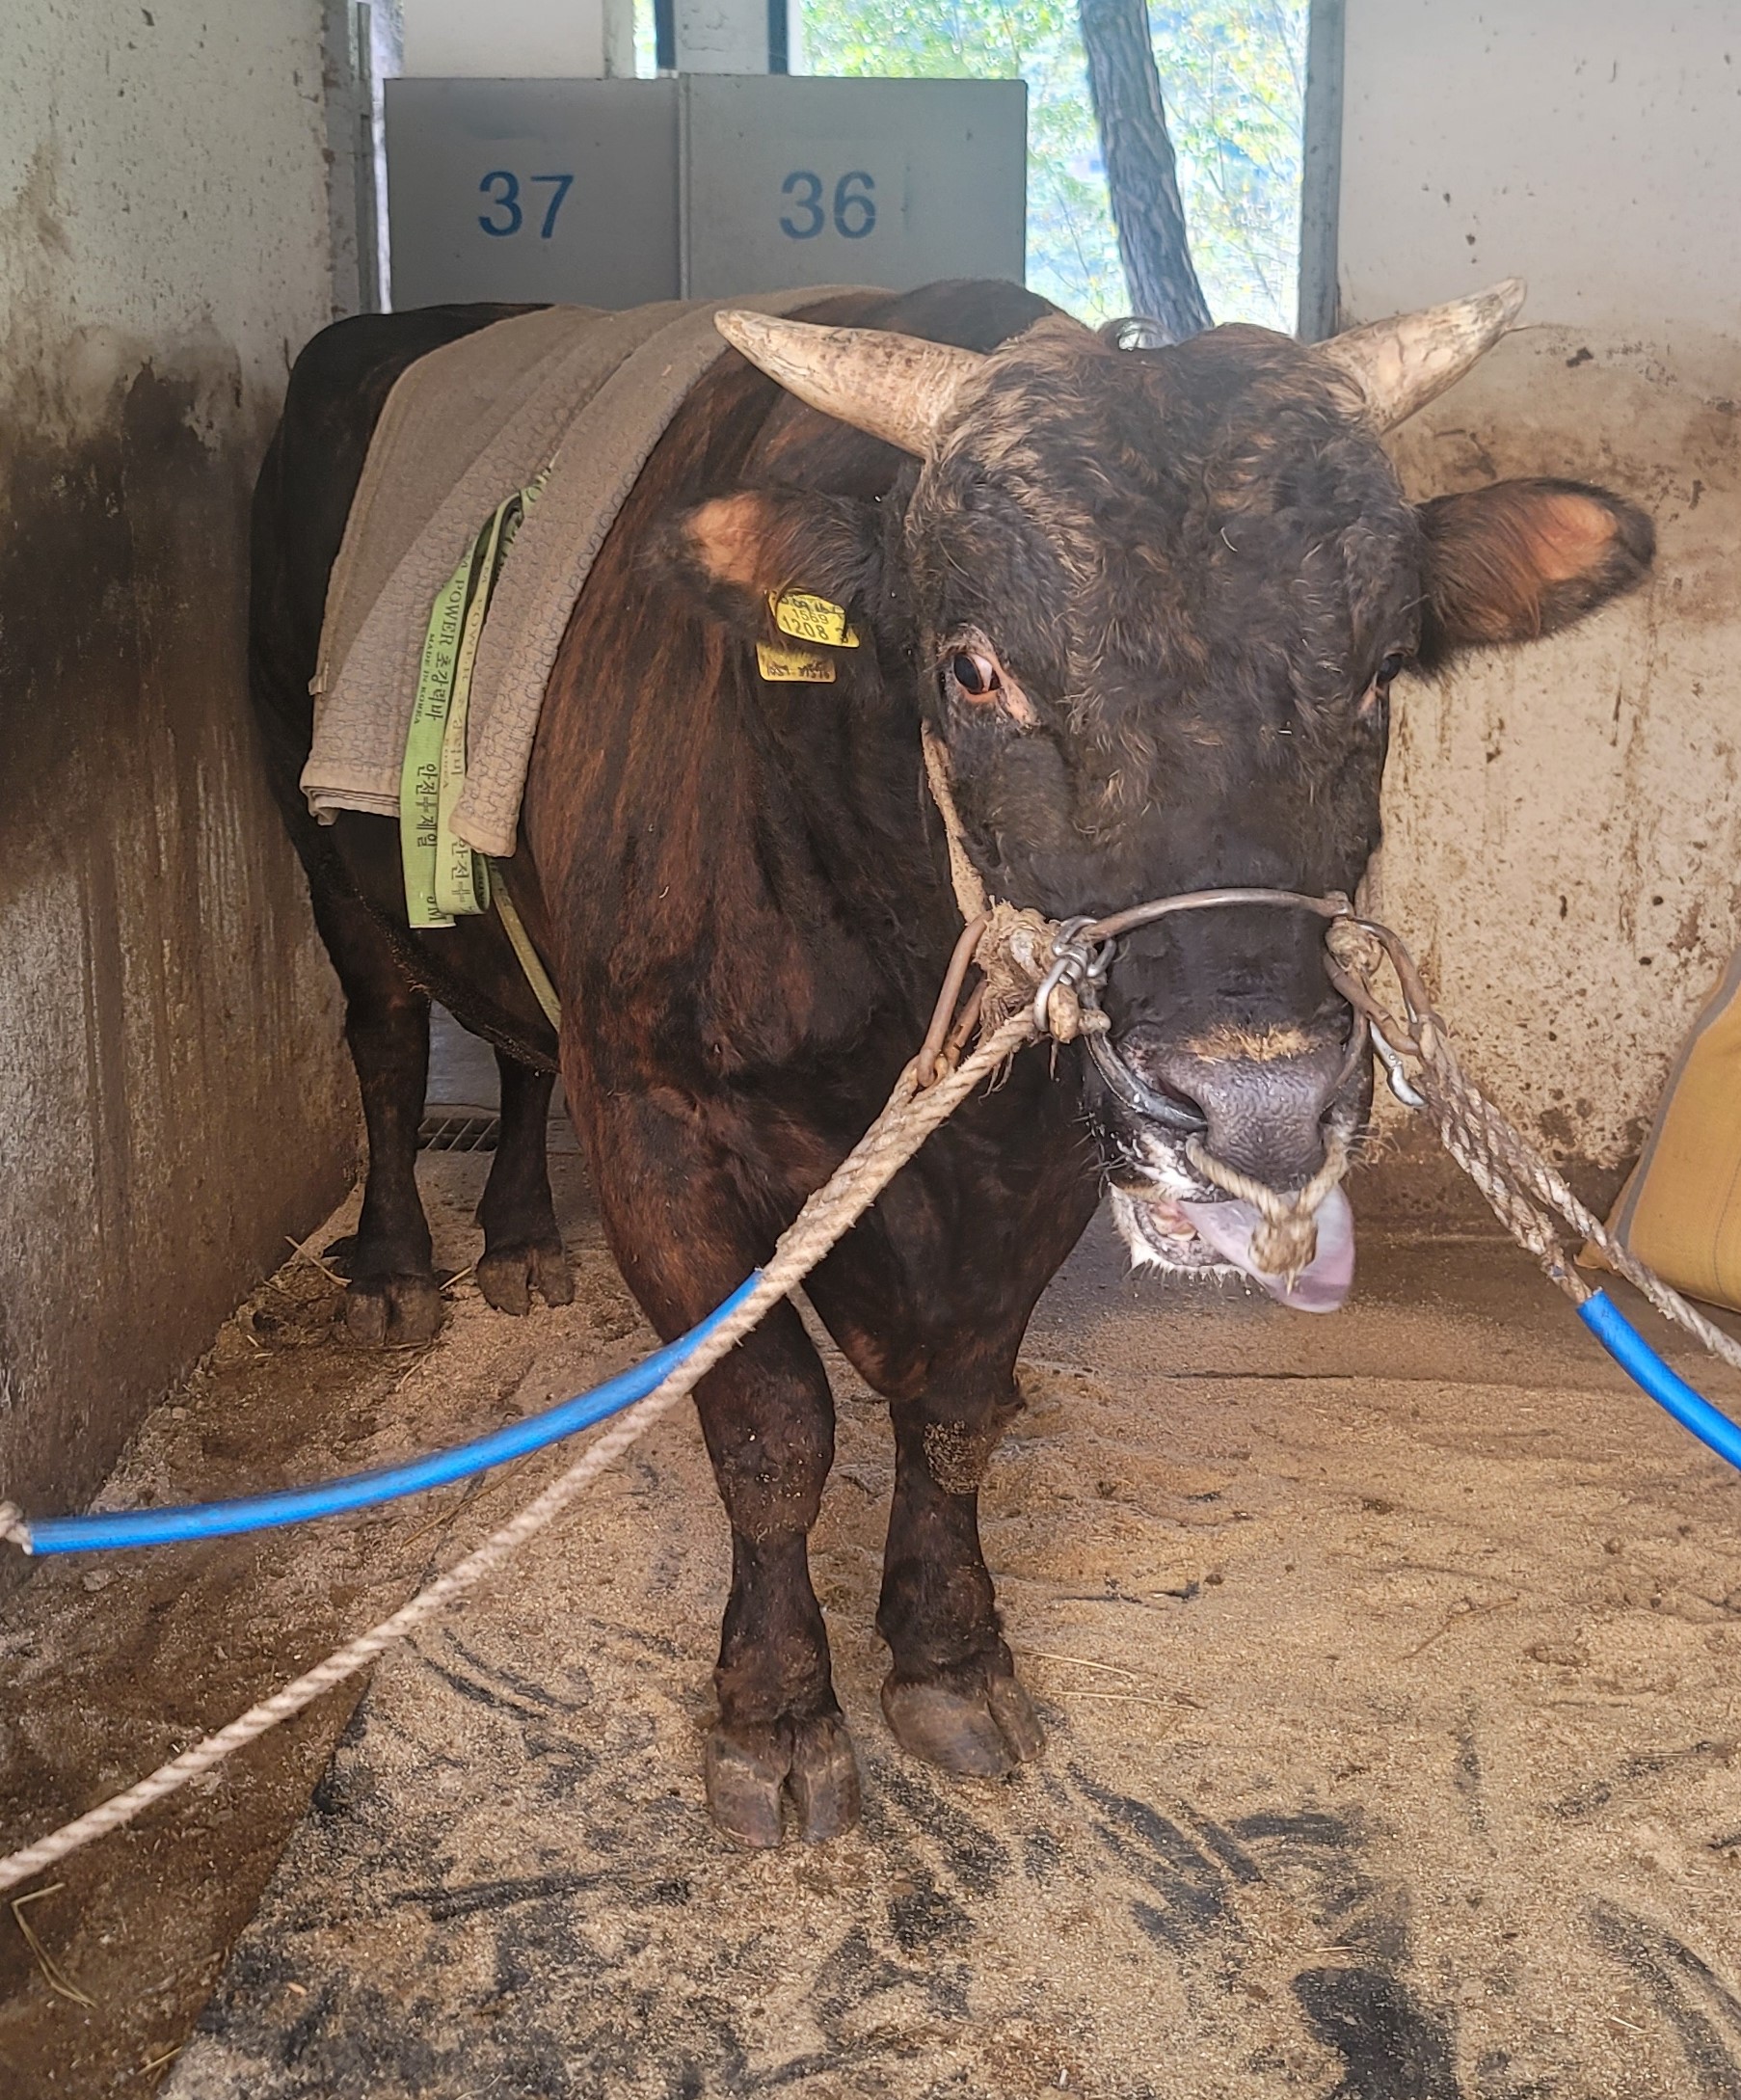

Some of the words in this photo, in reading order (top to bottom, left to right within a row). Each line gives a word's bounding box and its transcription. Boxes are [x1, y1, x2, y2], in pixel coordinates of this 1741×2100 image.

[477, 170, 575, 239] 37
[778, 170, 877, 239] 36
[438, 579, 466, 646] POWER
[782, 614, 829, 641] 1208
[791, 607, 830, 625] 1569
[422, 633, 436, 667] MADE
[421, 670, 431, 684] IN
[424, 651, 452, 721] 초강력바
[414, 686, 428, 725] KOREA
